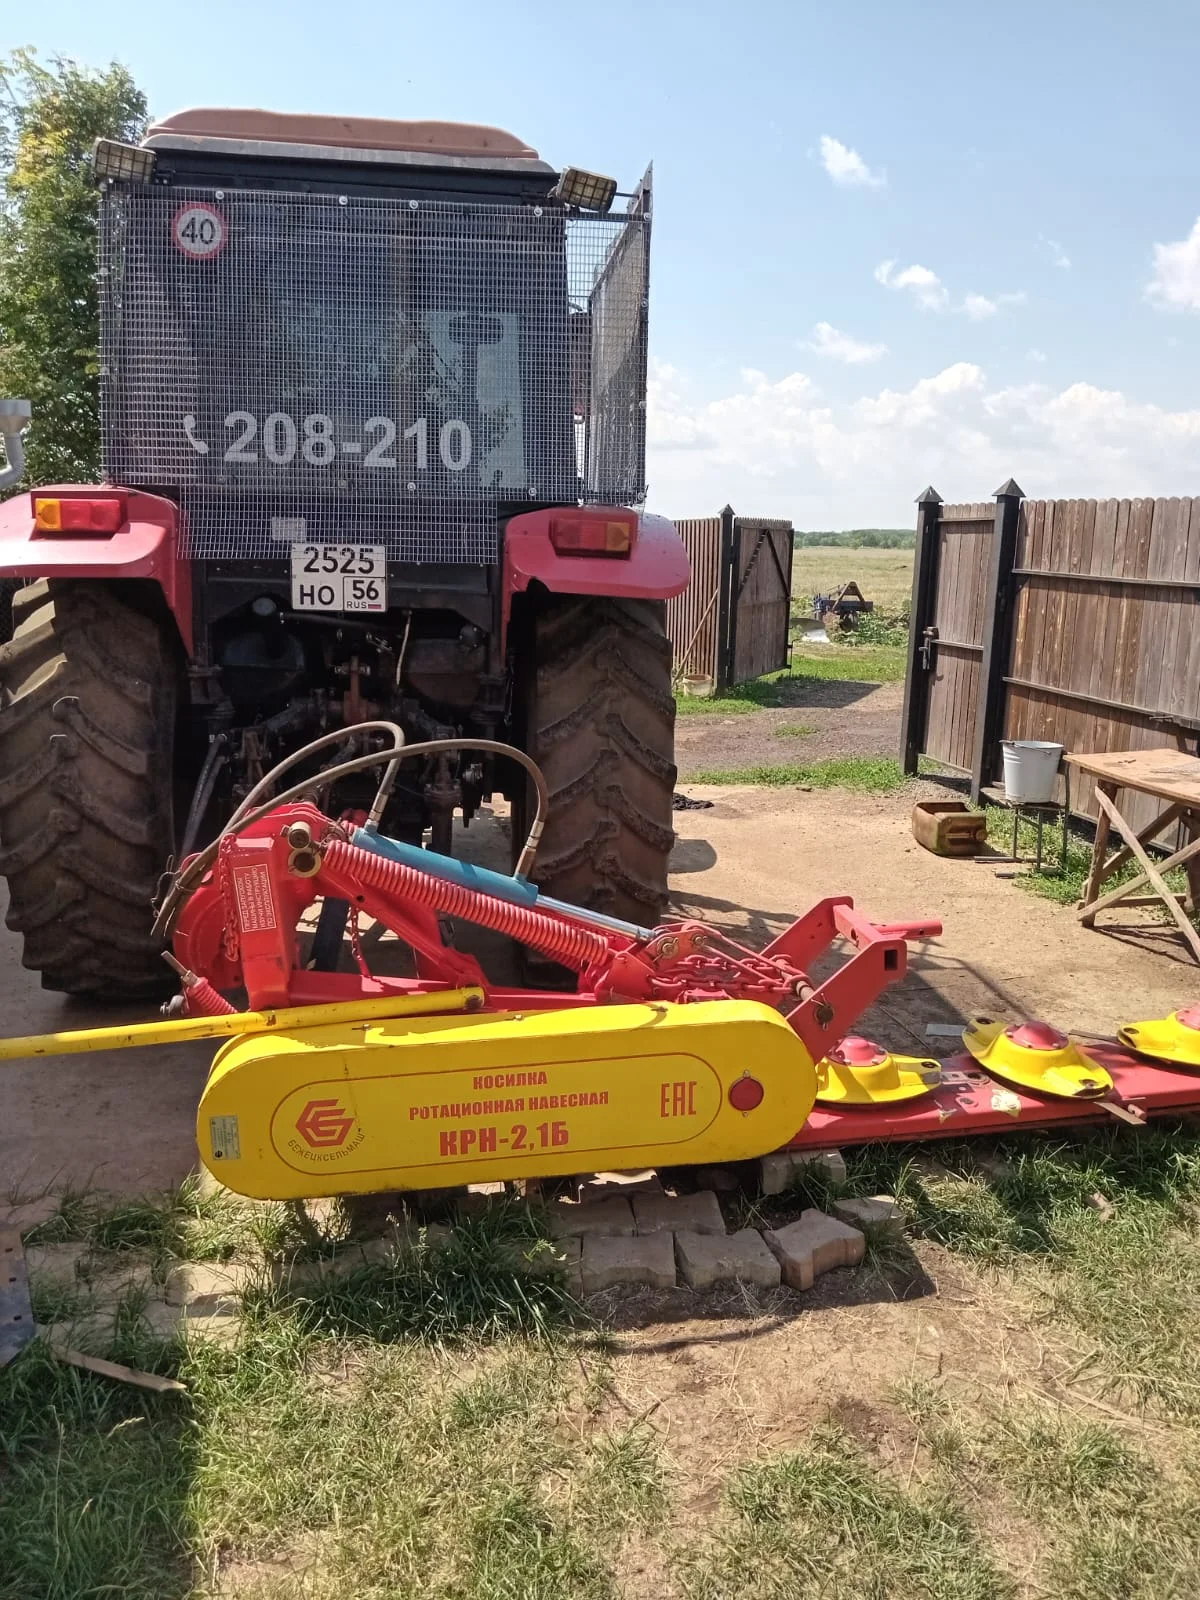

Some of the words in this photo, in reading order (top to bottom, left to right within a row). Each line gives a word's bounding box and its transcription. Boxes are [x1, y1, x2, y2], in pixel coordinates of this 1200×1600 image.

[181, 217, 215, 244] 40
[224, 410, 472, 471] 208-210
[303, 546, 374, 574] 2525
[352, 580, 379, 600] 56
[347, 601, 367, 609] RUS
[473, 1071, 547, 1090] КОСИЛКА
[409, 1097, 525, 1120] РОТАЦИОННАЯ
[528, 1091, 609, 1110] НАВЕСНАЯ
[440, 1121, 569, 1156] КРН-2,1Б
